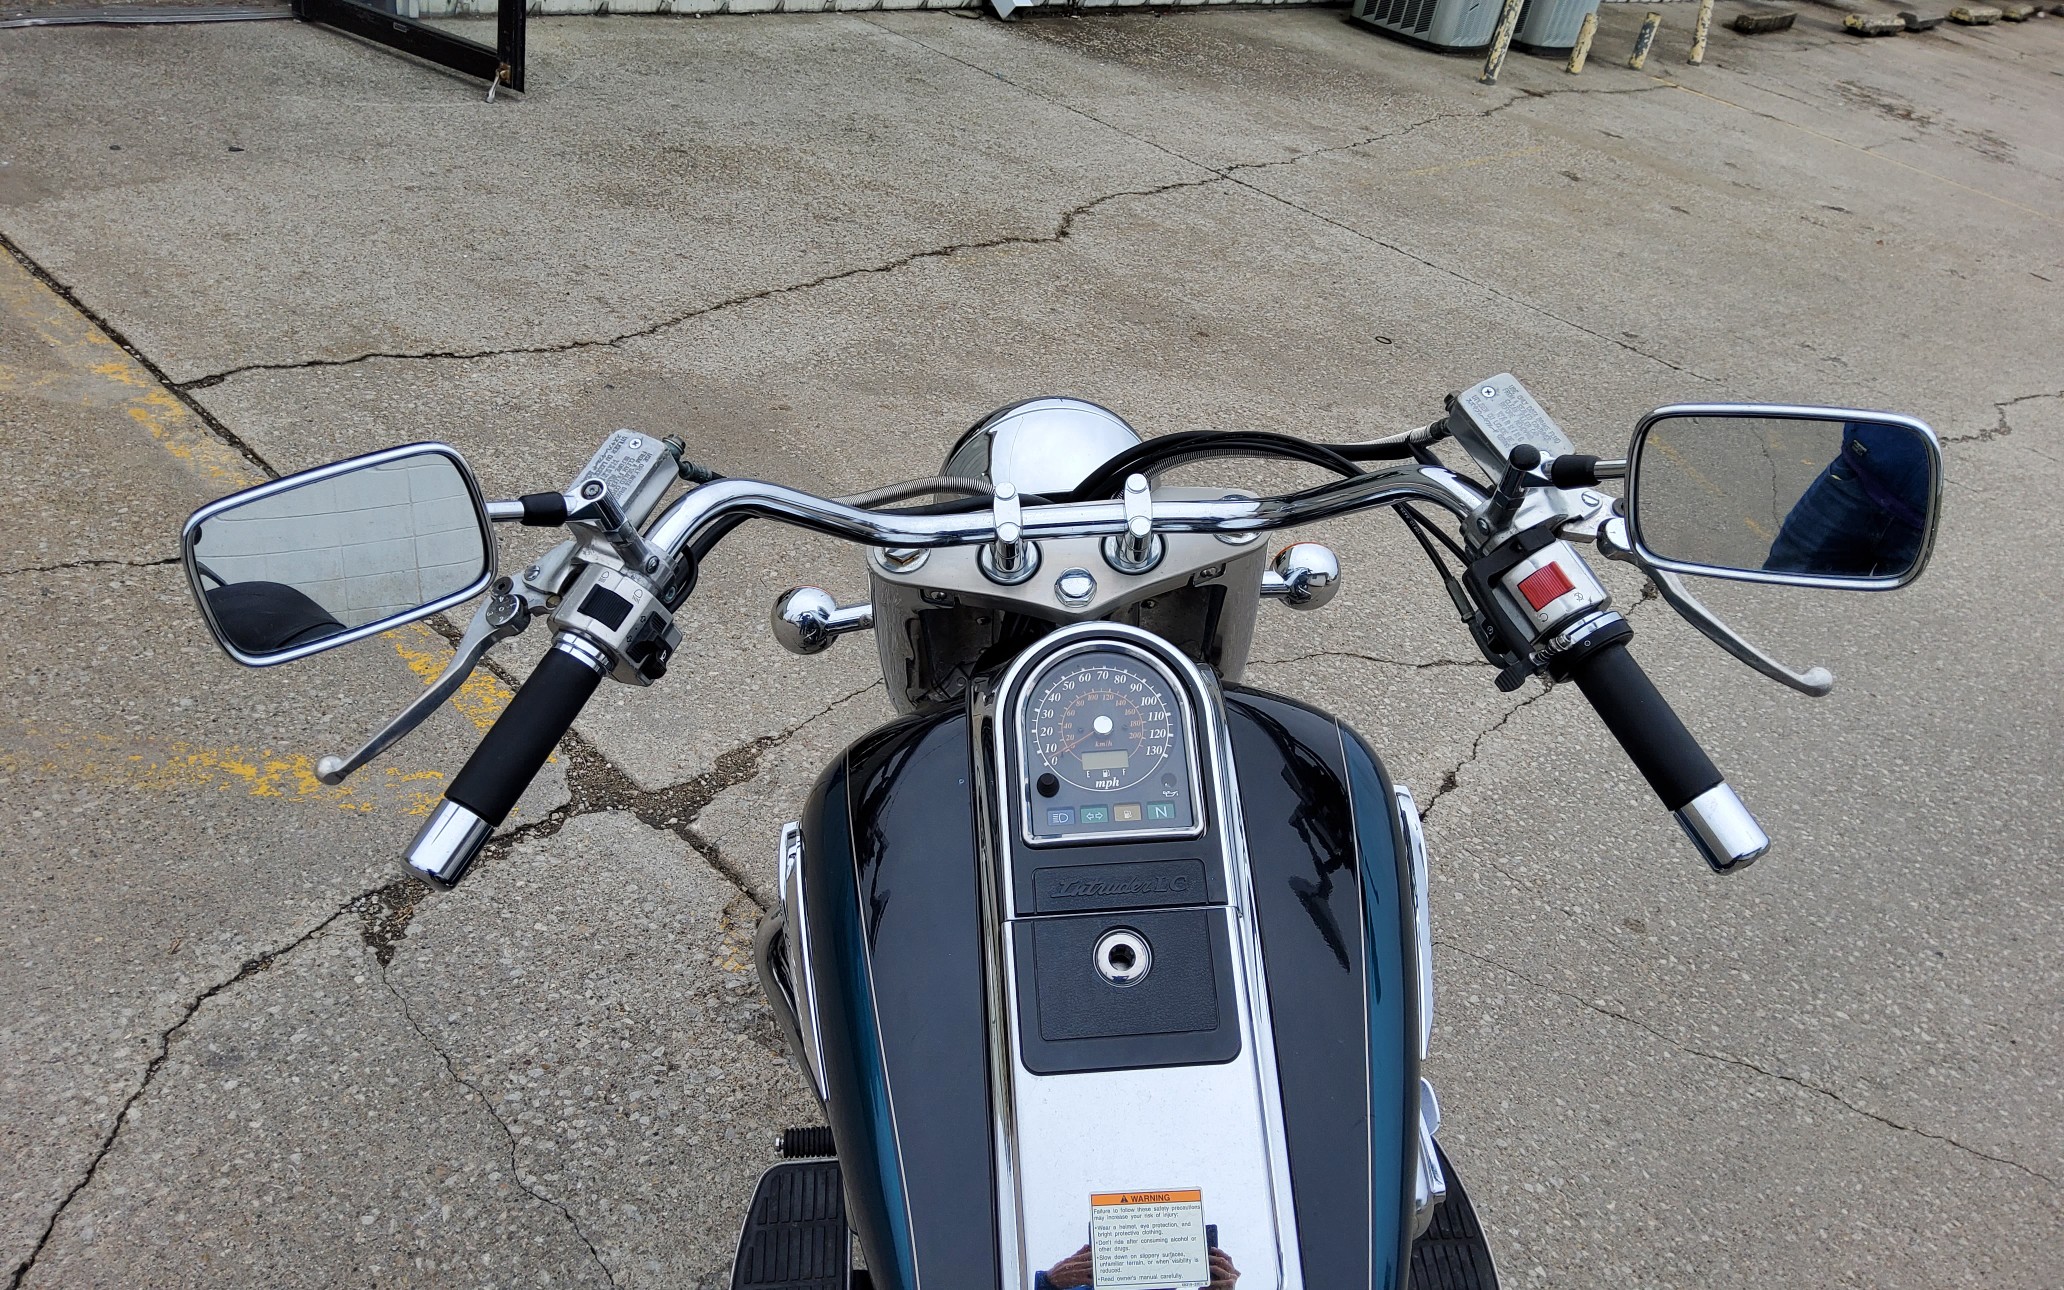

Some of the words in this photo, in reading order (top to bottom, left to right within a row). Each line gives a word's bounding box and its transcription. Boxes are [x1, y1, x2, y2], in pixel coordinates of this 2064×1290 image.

[1079, 673, 1091, 682] 60
[1097, 671, 1108, 680] 70
[1114, 675, 1126, 684] 80
[1062, 681, 1075, 690] 50
[1130, 683, 1142, 692] 90
[1048, 693, 1061, 702] 40
[1141, 697, 1157, 706] 100
[1041, 709, 1054, 718] 30
[1148, 711, 1164, 721] 110
[1040, 727, 1053, 736] 20
[1150, 729, 1166, 739] 120
[1045, 744, 1057, 753] 10
[1146, 746, 1162, 756] 130
[1052, 756, 1058, 766] 0
[1096, 778, 1119, 789] mph
[1155, 806, 1167, 819] N
[1050, 876, 1150, 898] Intruder
[1130, 1193, 1171, 1203] WARNING
